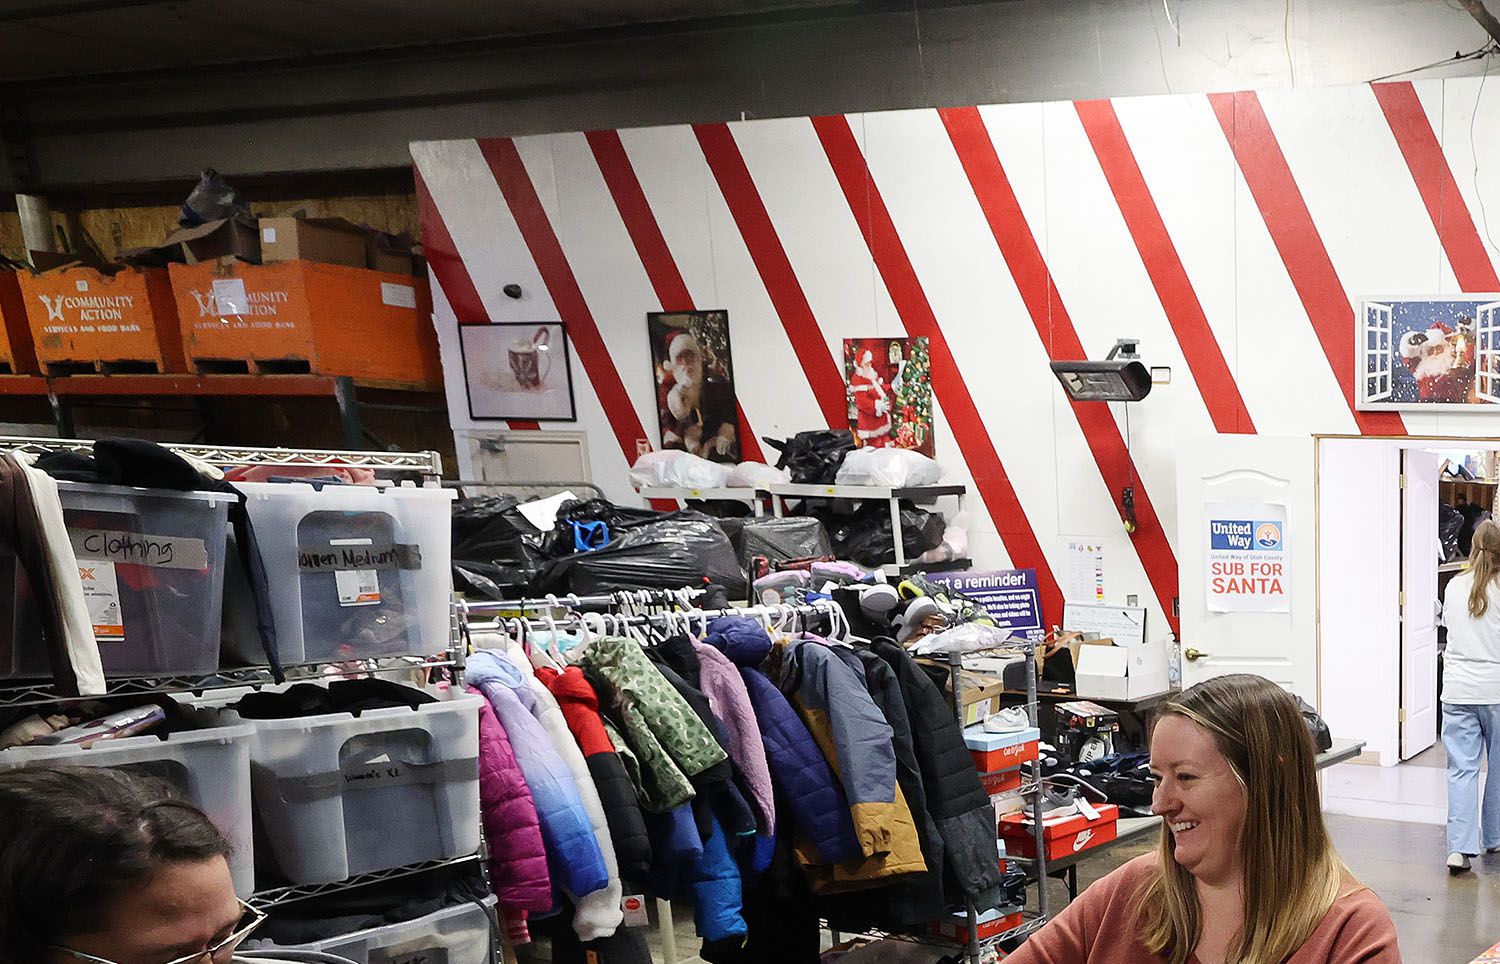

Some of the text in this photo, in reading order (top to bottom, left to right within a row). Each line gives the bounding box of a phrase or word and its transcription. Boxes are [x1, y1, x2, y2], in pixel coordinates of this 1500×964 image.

[64, 295, 133, 310] COMMUNITY
[80, 307, 122, 321] ACTION
[1212, 523, 1251, 535] United
[84, 534, 173, 564] Clothing
[1227, 535, 1251, 550] Way
[342, 548, 399, 567] Medium
[1212, 562, 1283, 576] SUB FOR
[954, 580, 962, 589] a
[965, 573, 1026, 589] reminder!
[1212, 577, 1283, 595] SANTA
